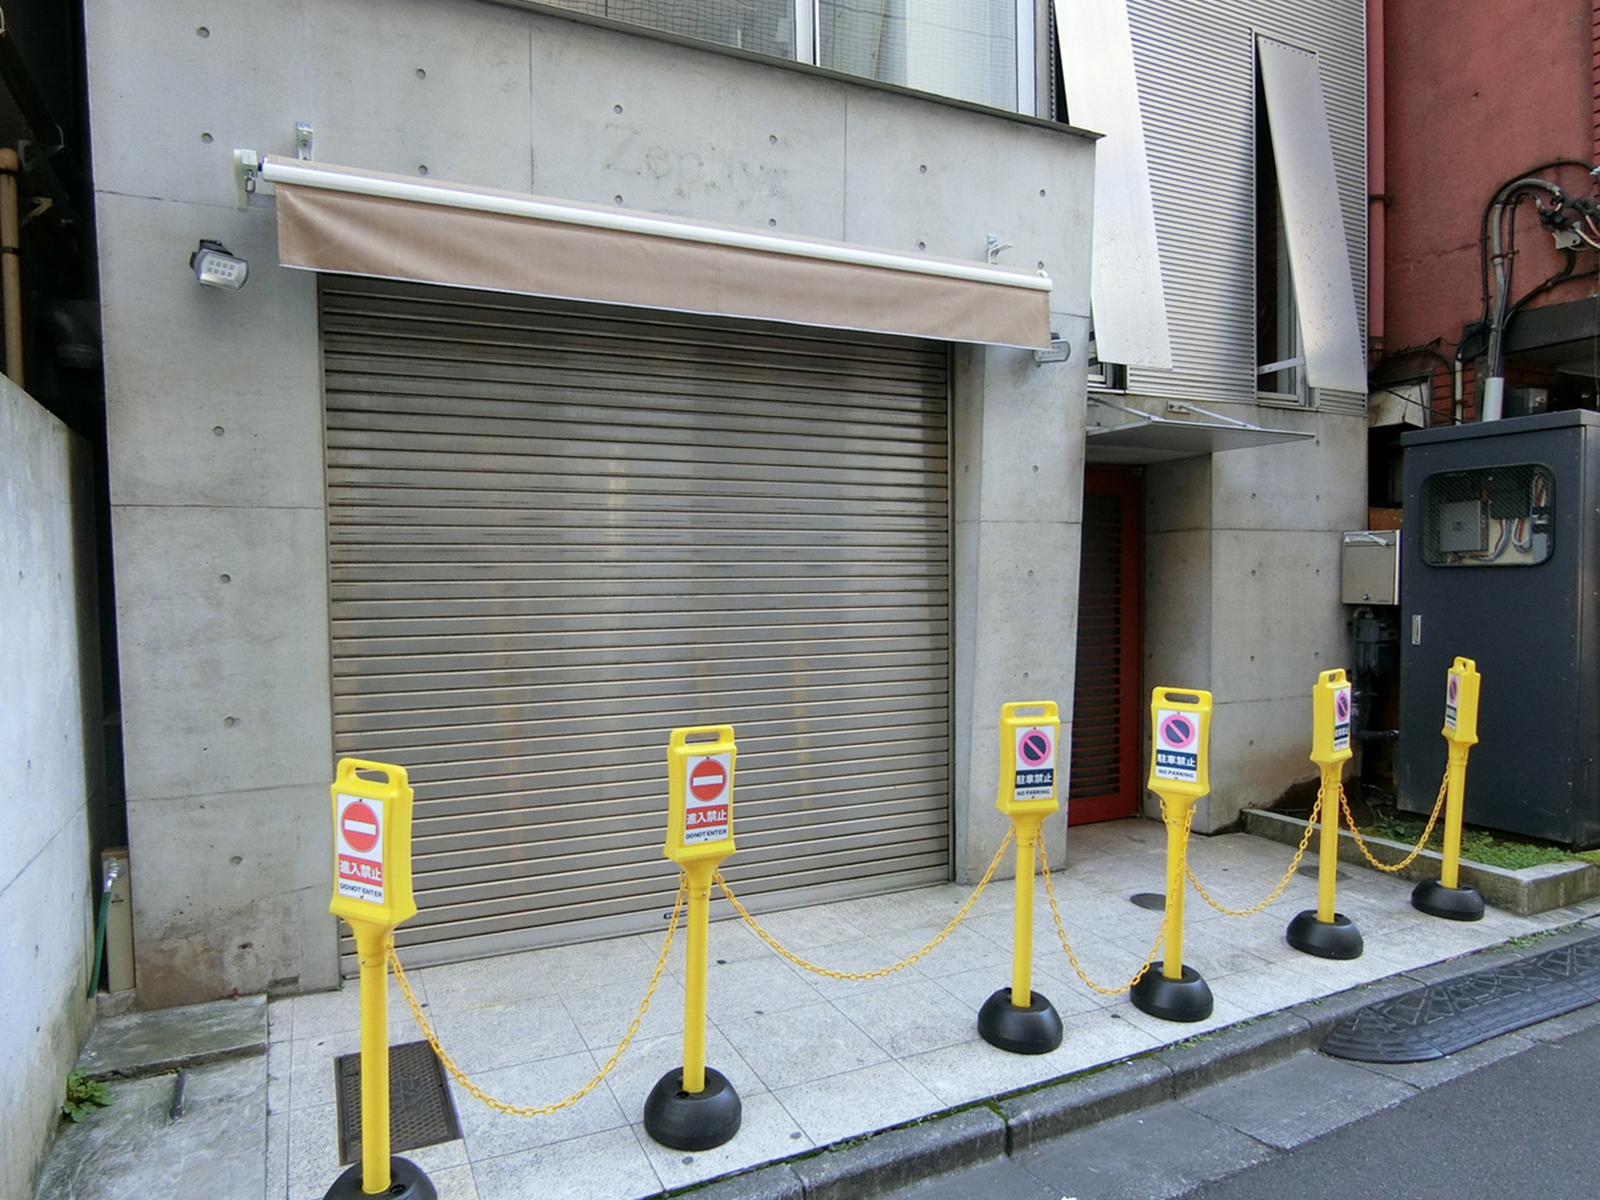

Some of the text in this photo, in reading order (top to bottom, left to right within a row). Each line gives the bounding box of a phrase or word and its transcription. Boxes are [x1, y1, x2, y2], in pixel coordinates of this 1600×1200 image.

[1157, 753, 1196, 767] 駐車禁止
[1016, 773, 1052, 785] 駐車禁止
[1168, 770, 1194, 778] PARKING
[686, 809, 727, 825] 進入禁止
[706, 829, 727, 837] ENTER
[339, 860, 382, 881] 進入禁止
[362, 887, 383, 898] ENTER
